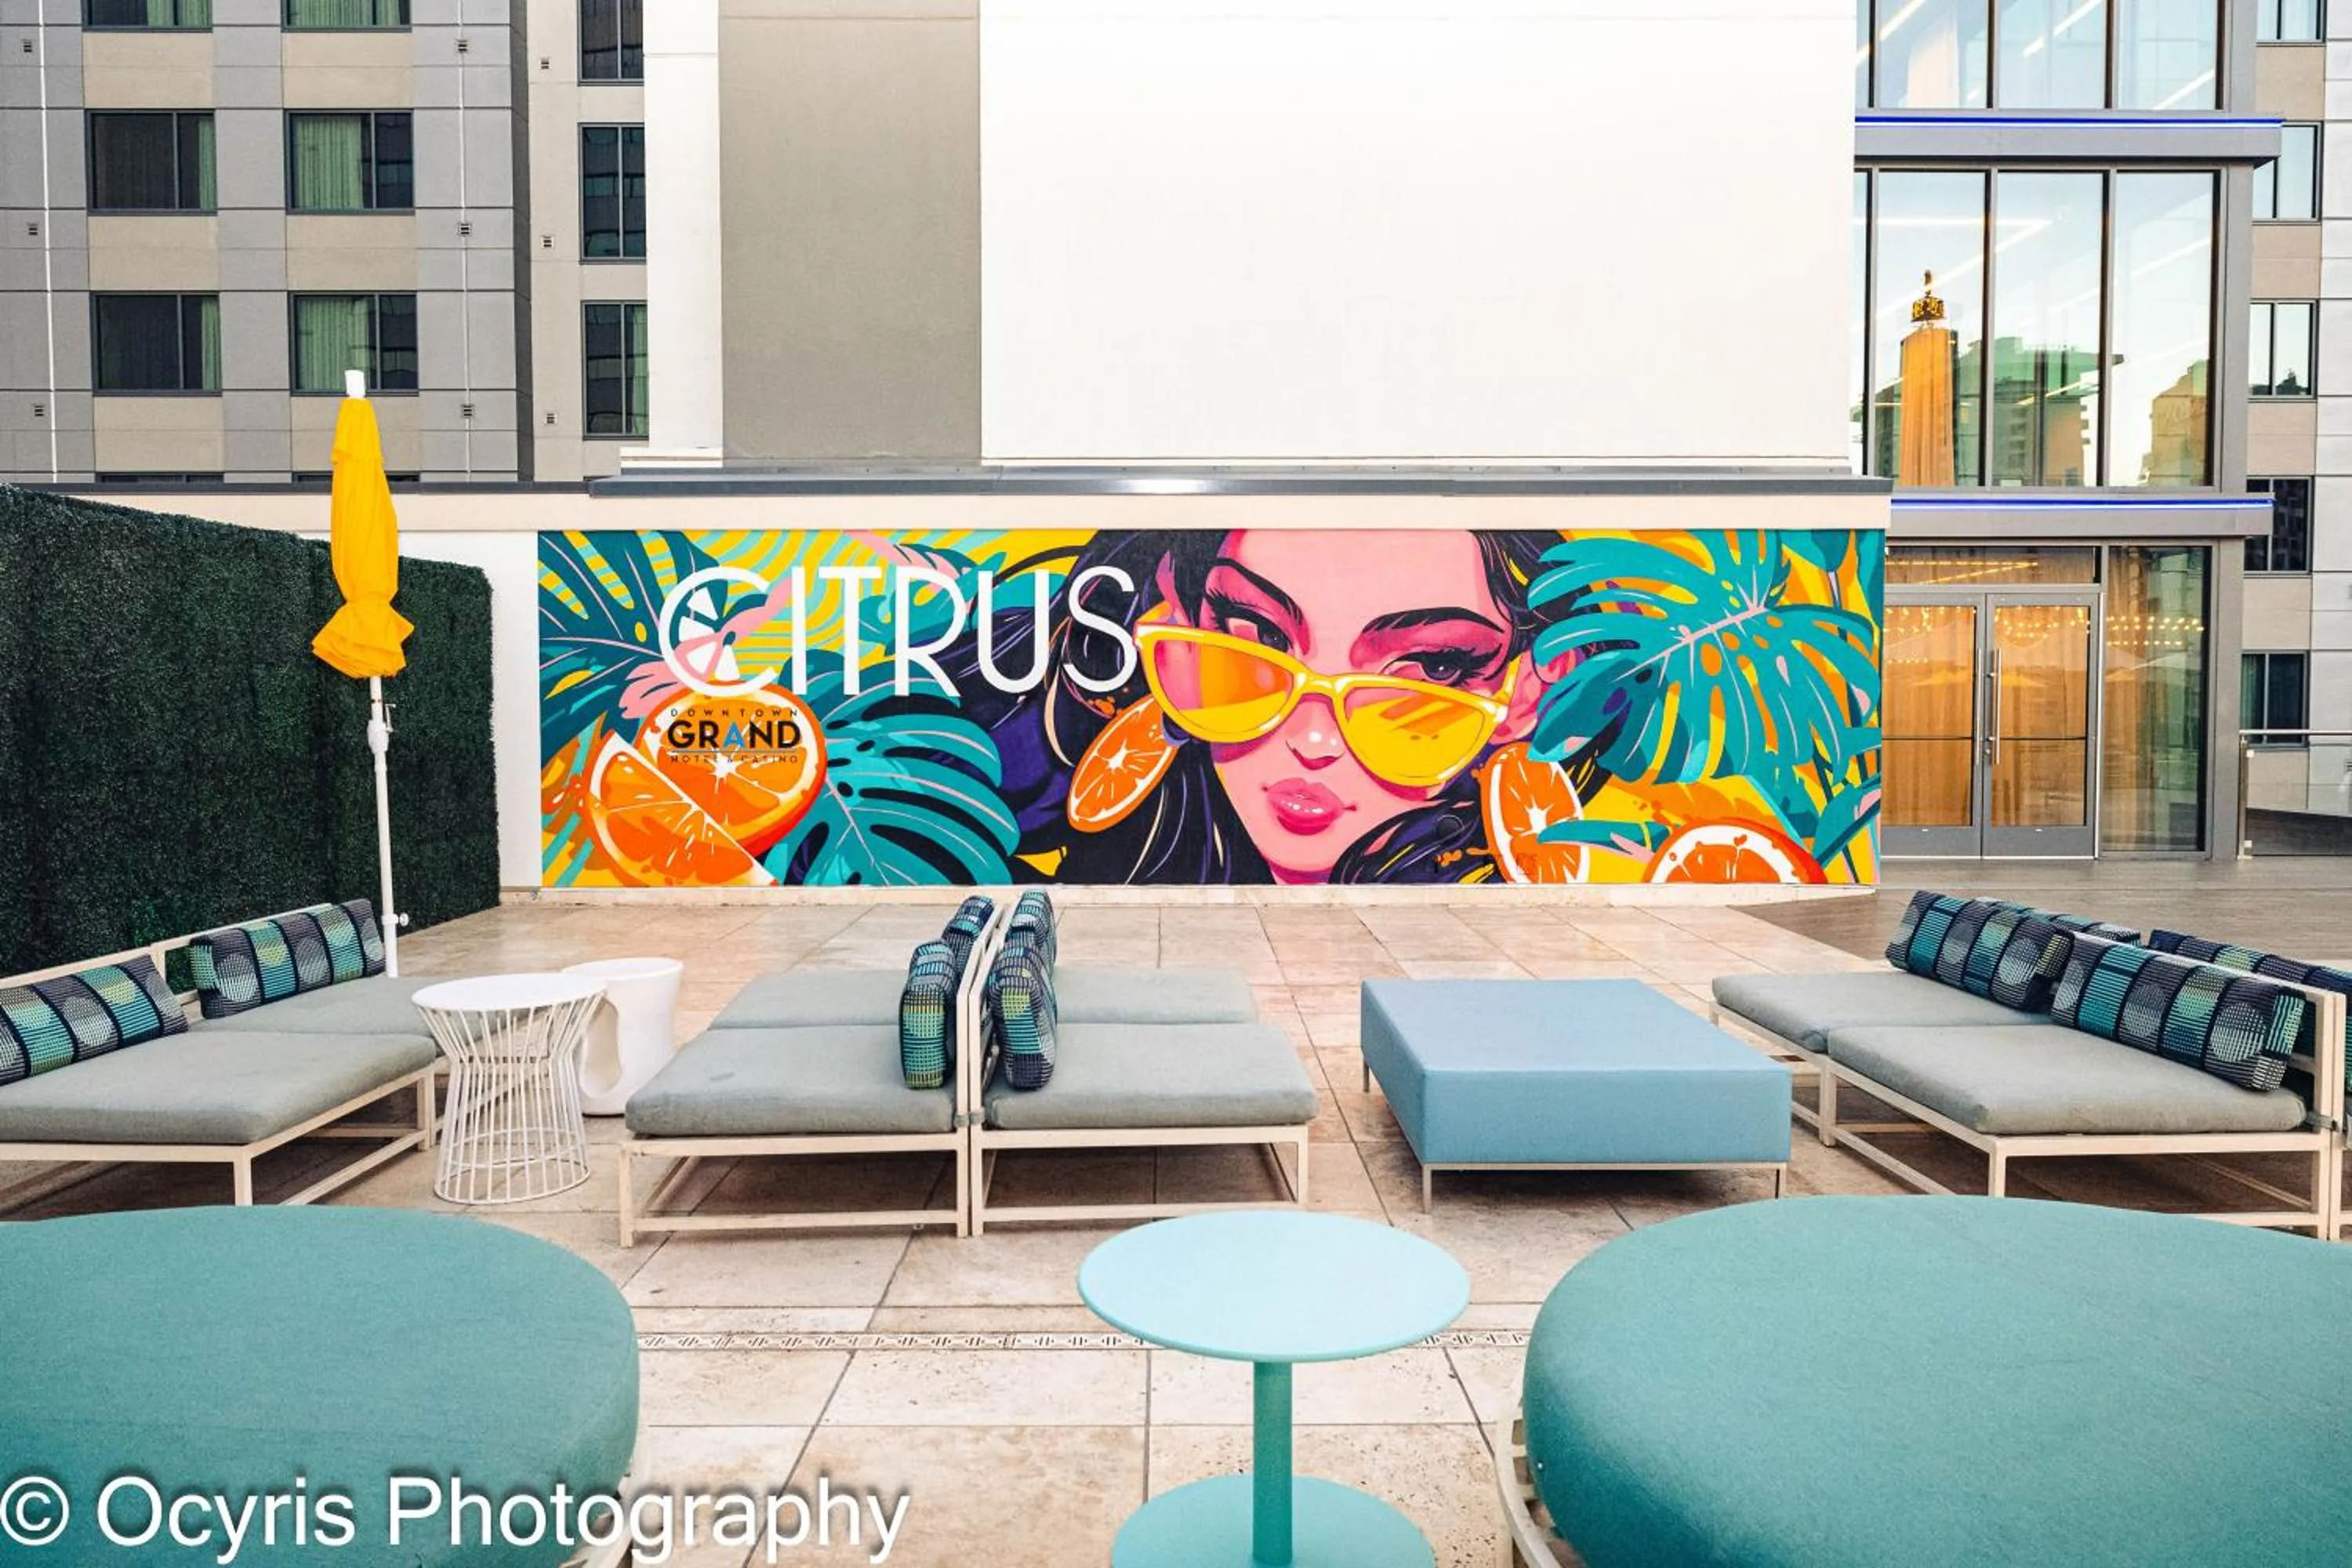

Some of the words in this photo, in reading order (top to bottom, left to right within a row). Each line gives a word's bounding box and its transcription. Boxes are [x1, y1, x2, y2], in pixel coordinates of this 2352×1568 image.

[658, 565, 1138, 697] CITRUS
[670, 708, 797, 717] DOWNTOWN
[667, 720, 801, 749] GRAND
